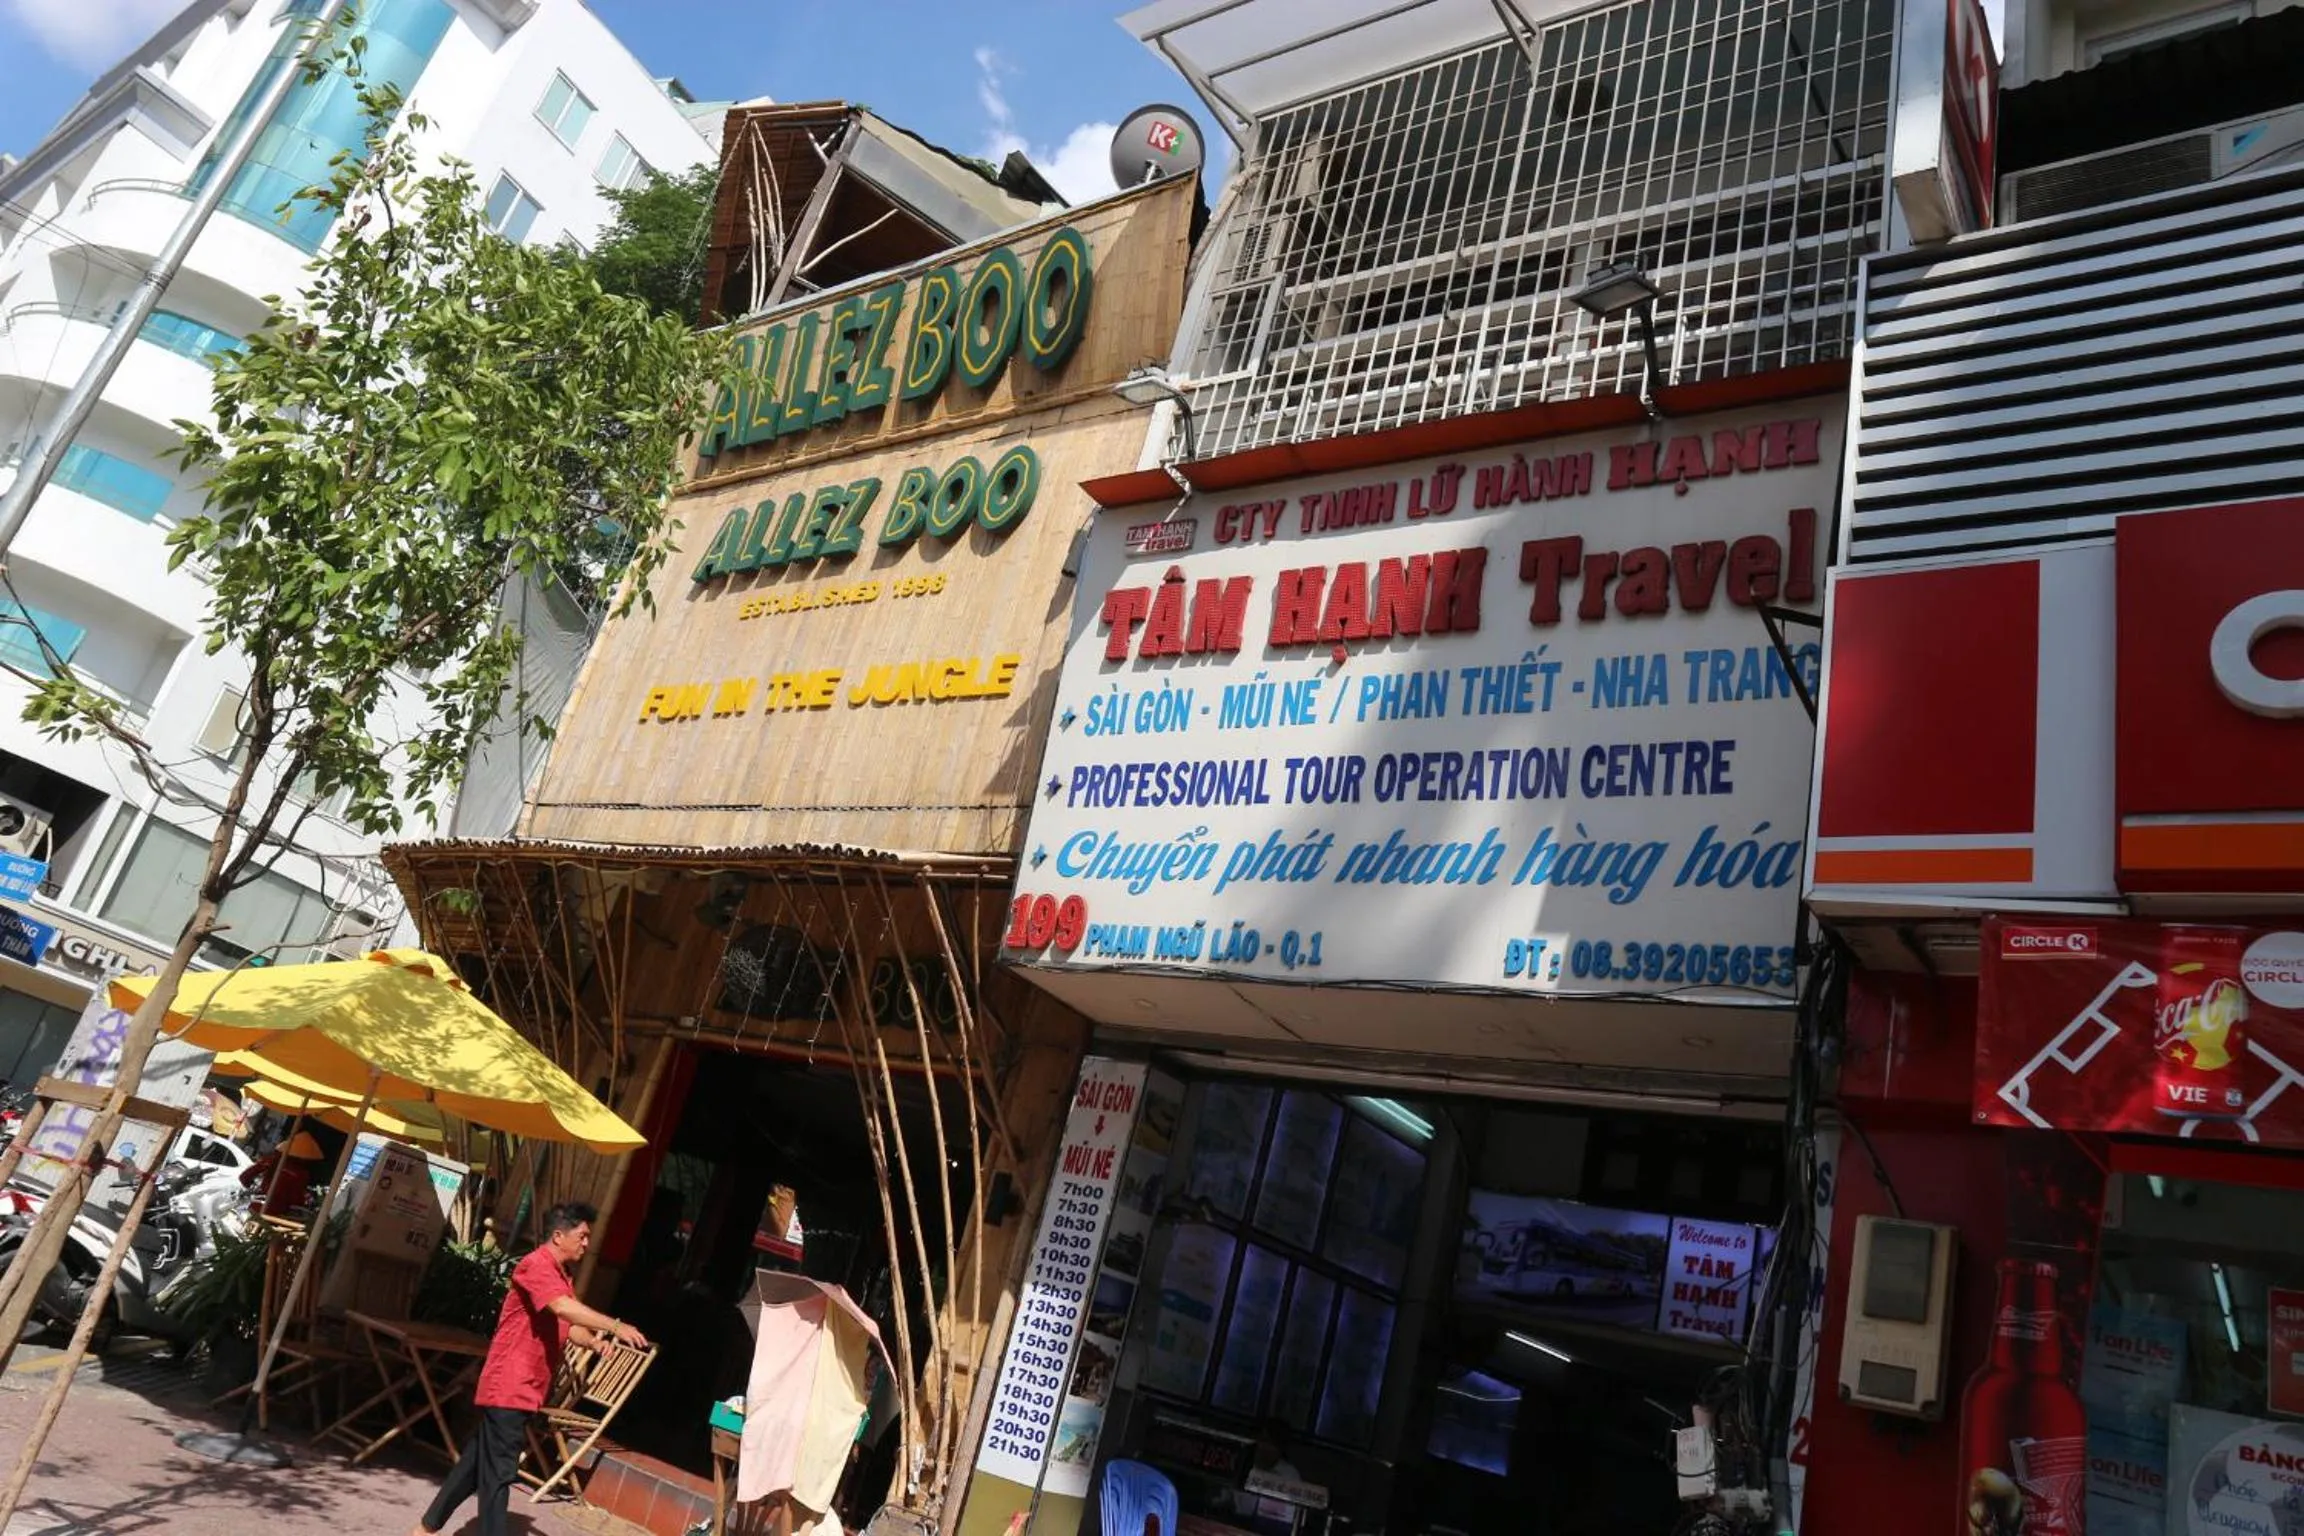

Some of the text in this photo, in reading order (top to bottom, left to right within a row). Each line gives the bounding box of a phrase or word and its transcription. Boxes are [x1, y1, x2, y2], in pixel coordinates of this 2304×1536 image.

[1149, 123, 1180, 150] K+
[699, 226, 1093, 456] ALLEZ BOO
[1213, 419, 1821, 544] CTY TNHH LỮ HÀNH HẠNH
[690, 445, 1043, 583] ALLEZ BOO
[739, 580, 882, 620] ESTABLISHED
[1102, 508, 1816, 666] TÂM HẠNH Travel
[638, 654, 1022, 724] FUN IN THE JUNGLE
[1084, 683, 1131, 736] SÀI
[1135, 678, 1194, 734] GÒN
[1219, 671, 1276, 729] MŨI
[1279, 667, 1328, 726] NÉ
[1357, 668, 1450, 722] PHAN
[1461, 645, 1562, 716] THIẾT
[1592, 654, 1669, 709] NHA
[1684, 643, 1821, 704] TRANG
[1068, 740, 1735, 808] PROFESSIONAL TOUR OPERATION CENTRE
[1056, 821, 1802, 905] Chuyển phát nhanh hàng hóa
[1006, 893, 1088, 951] 199
[1154, 920, 1206, 961] NGŨ
[1210, 920, 1260, 964] LÃO
[1280, 930, 1323, 969] Q.1
[2010, 933, 2089, 951] CIRCLE K
[1572, 939, 1795, 986] 08.39205653
[1076, 1074, 1136, 1114] SÀI GÒN
[2168, 1084, 2210, 1102] VIE
[1062, 1140, 1117, 1180] MŨI NÉ
[1062, 1181, 1103, 1199] 7h00
[1057, 1198, 1099, 1216] 7h30
[1053, 1215, 1096, 1233] 8h30
[1678, 1223, 1747, 1249] Welcome to
[1048, 1231, 1091, 1250] 9h30
[1039, 1247, 1090, 1268] 10h30
[1684, 1254, 1736, 1280] TÂM
[1035, 1264, 1086, 1285] 11h30
[1031, 1281, 1082, 1303] 12h30
[1026, 1299, 1077, 1320] 13h30
[1021, 1315, 1073, 1337] 14h30
[1669, 1310, 1734, 1336] Travel
[1017, 1332, 1068, 1355] 15h30
[1012, 1349, 1063, 1372] 16h30
[1007, 1366, 1059, 1390] 17h30
[1003, 1383, 1054, 1408] 18h30
[999, 1400, 1050, 1426] 19h30
[993, 1418, 1045, 1444] 20h30
[988, 1435, 1041, 1462] 21h30
